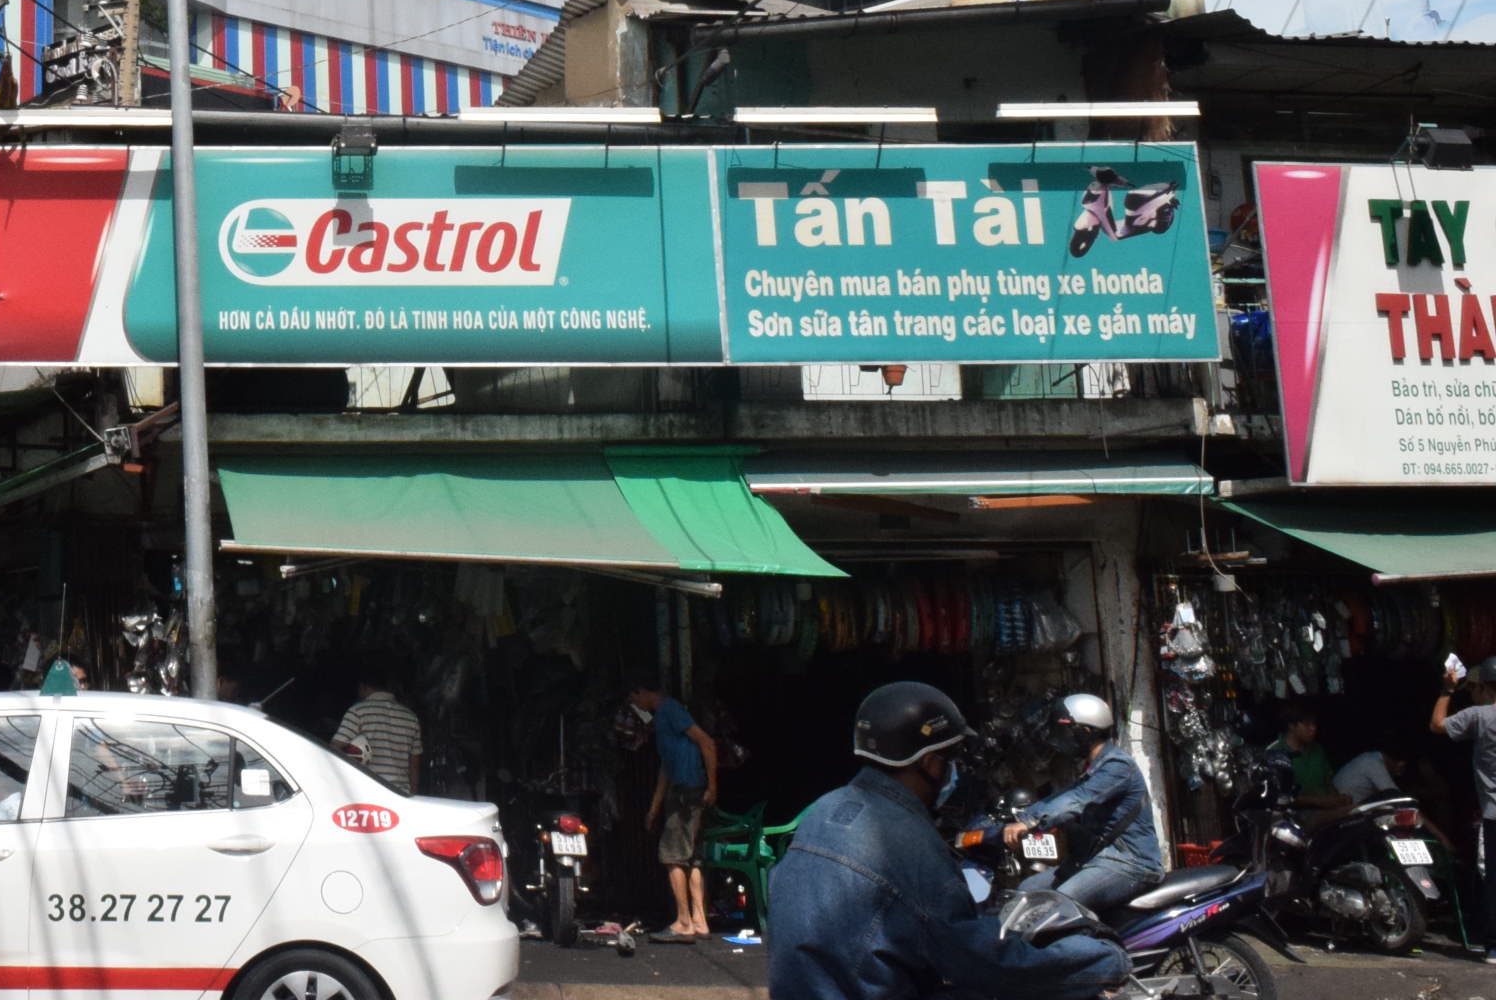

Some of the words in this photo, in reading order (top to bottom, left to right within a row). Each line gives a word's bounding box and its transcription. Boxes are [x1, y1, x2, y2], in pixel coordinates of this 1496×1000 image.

[738, 169, 893, 248] Tấn
[915, 177, 1045, 247] Tài
[305, 207, 544, 275] Castrol
[1368, 199, 1470, 271] TAY
[744, 269, 834, 303] Chuyên
[840, 276, 892, 297] mua
[897, 268, 942, 297] bán
[947, 269, 992, 304] phụ
[997, 268, 1051, 302] tùng
[1057, 275, 1086, 296] xe
[1091, 267, 1164, 296] honda
[219, 308, 251, 331] HƠN
[255, 304, 276, 331] CẢ
[315, 306, 361, 331] NHỚT.
[364, 306, 385, 331] ĐÓ
[390, 306, 409, 331] LÀ
[411, 309, 448, 331] TINH
[454, 309, 485, 330] HOA
[488, 304, 519, 330] CỦA
[522, 306, 556, 333] MỘT
[560, 306, 602, 330] CÔNG
[606, 307, 652, 333] NGHỆ.
[748, 309, 793, 338] Sơn
[847, 309, 889, 337] tân
[893, 310, 957, 342] trang
[962, 307, 1007, 337] các
[1012, 308, 1056, 344] loại
[1063, 314, 1092, 336] xe
[1098, 303, 1142, 342] gắn
[1147, 306, 1196, 340] máy
[1375, 277, 1496, 366] THÀ
[1391, 377, 1420, 398] Bảo
[1445, 378, 1471, 398] sửa
[1399, 435, 1415, 453] Số
[1418, 438, 1425, 453] 5
[1428, 434, 1472, 456] Nguyễn
[1402, 462, 1421, 475] ĐT:
[336, 809, 393, 828] 12719
[47, 894, 136, 923] 38.27
[147, 894, 185, 923] 27
[194, 894, 232, 923] 27
